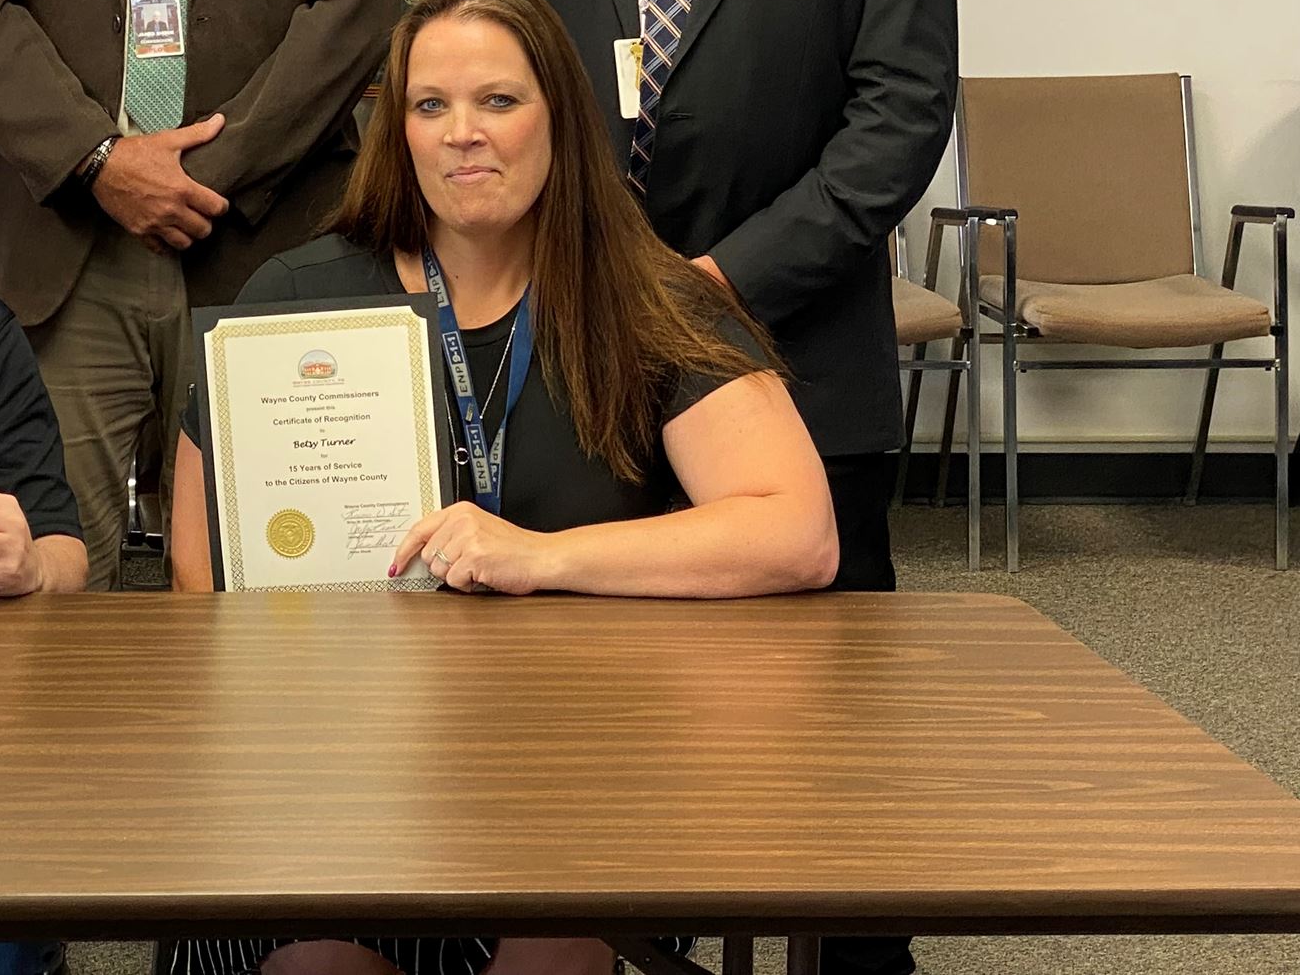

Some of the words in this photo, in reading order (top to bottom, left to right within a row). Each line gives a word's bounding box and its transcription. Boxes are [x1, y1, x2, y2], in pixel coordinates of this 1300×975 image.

[454, 367, 469, 393] ENP
[261, 395, 287, 405] Wayne
[288, 394, 317, 403] County
[319, 391, 379, 401] Commissioners
[273, 416, 313, 426] Certificate
[314, 416, 322, 424] of
[324, 413, 371, 424] Recognition
[293, 439, 318, 449] Betsy
[320, 437, 356, 448] Turner
[299, 463, 322, 472] Years
[323, 463, 332, 471] of
[333, 461, 362, 470] Service
[265, 479, 273, 487] to
[274, 478, 287, 486] the
[289, 477, 320, 486] Citizens
[322, 476, 330, 484] of
[332, 475, 358, 485] Wayne
[359, 473, 388, 483] County
[473, 461, 488, 490] ENP
